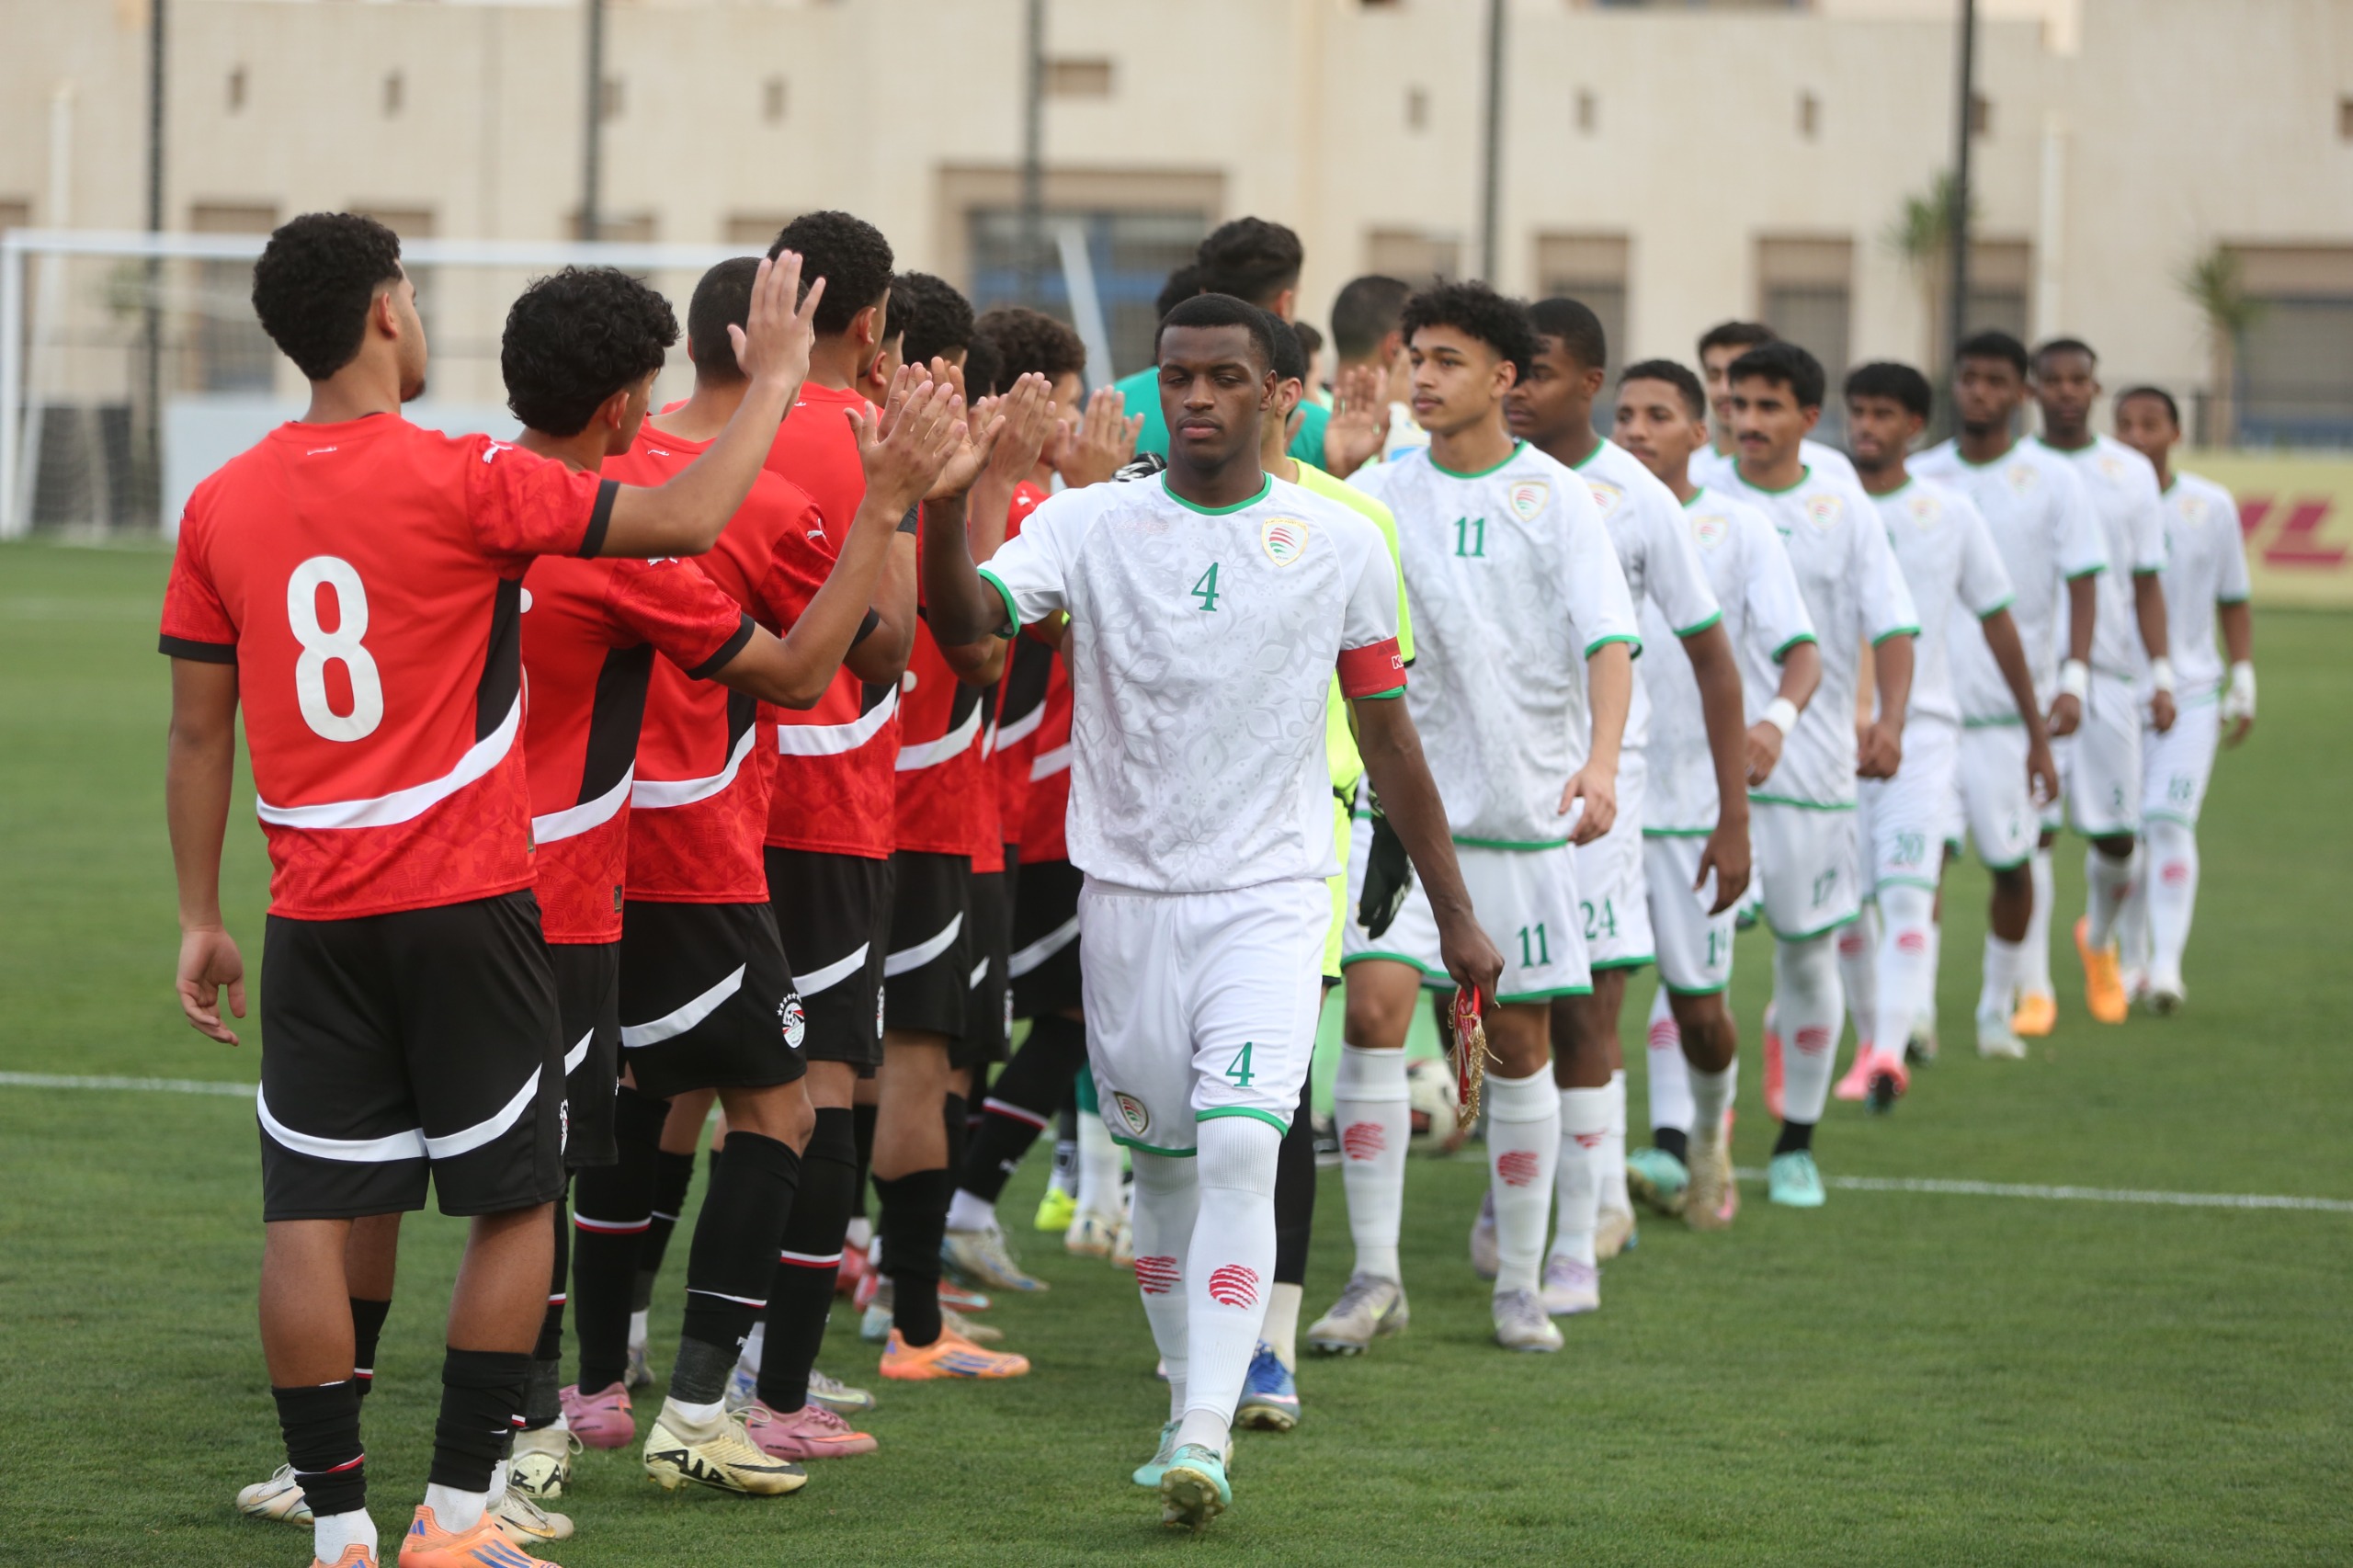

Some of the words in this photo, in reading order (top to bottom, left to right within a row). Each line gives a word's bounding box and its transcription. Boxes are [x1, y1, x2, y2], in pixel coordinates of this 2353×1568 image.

[1454, 517, 1485, 558] 11
[1190, 562, 1220, 612] 4
[287, 554, 384, 743] 8
[1579, 898, 1618, 940] 24
[1518, 922, 1552, 969] 11
[1225, 1041, 1256, 1087] 4
